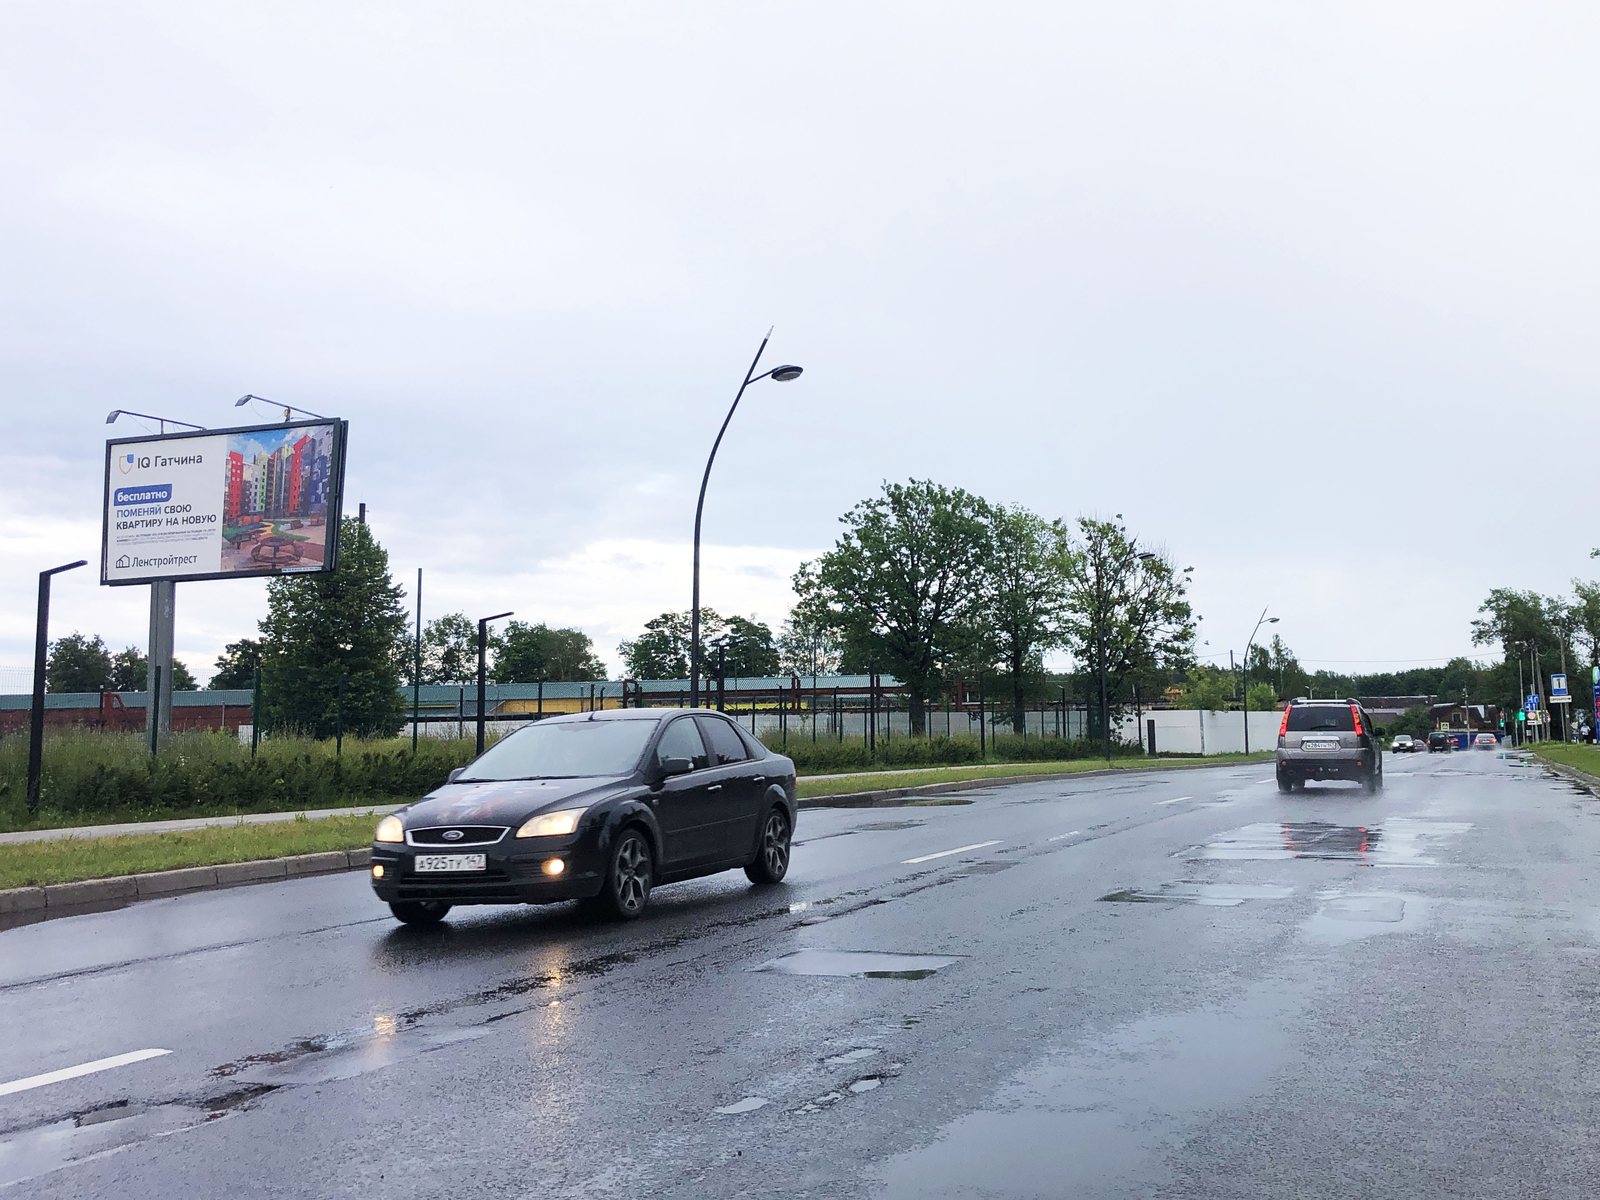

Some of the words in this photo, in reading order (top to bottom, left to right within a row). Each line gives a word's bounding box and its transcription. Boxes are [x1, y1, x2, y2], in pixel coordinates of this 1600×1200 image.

[137, 456, 151, 469] IQ
[154, 454, 203, 467] Гатчина
[117, 490, 168, 502] бесплатно
[116, 505, 162, 518] ПОМЕНЯЙ
[164, 504, 192, 514] СВОЮ
[116, 518, 163, 530] КВАРТИРУ
[165, 517, 179, 527] НА
[182, 514, 217, 525] НОВУЮ
[132, 554, 198, 568] Ленстройтрест
